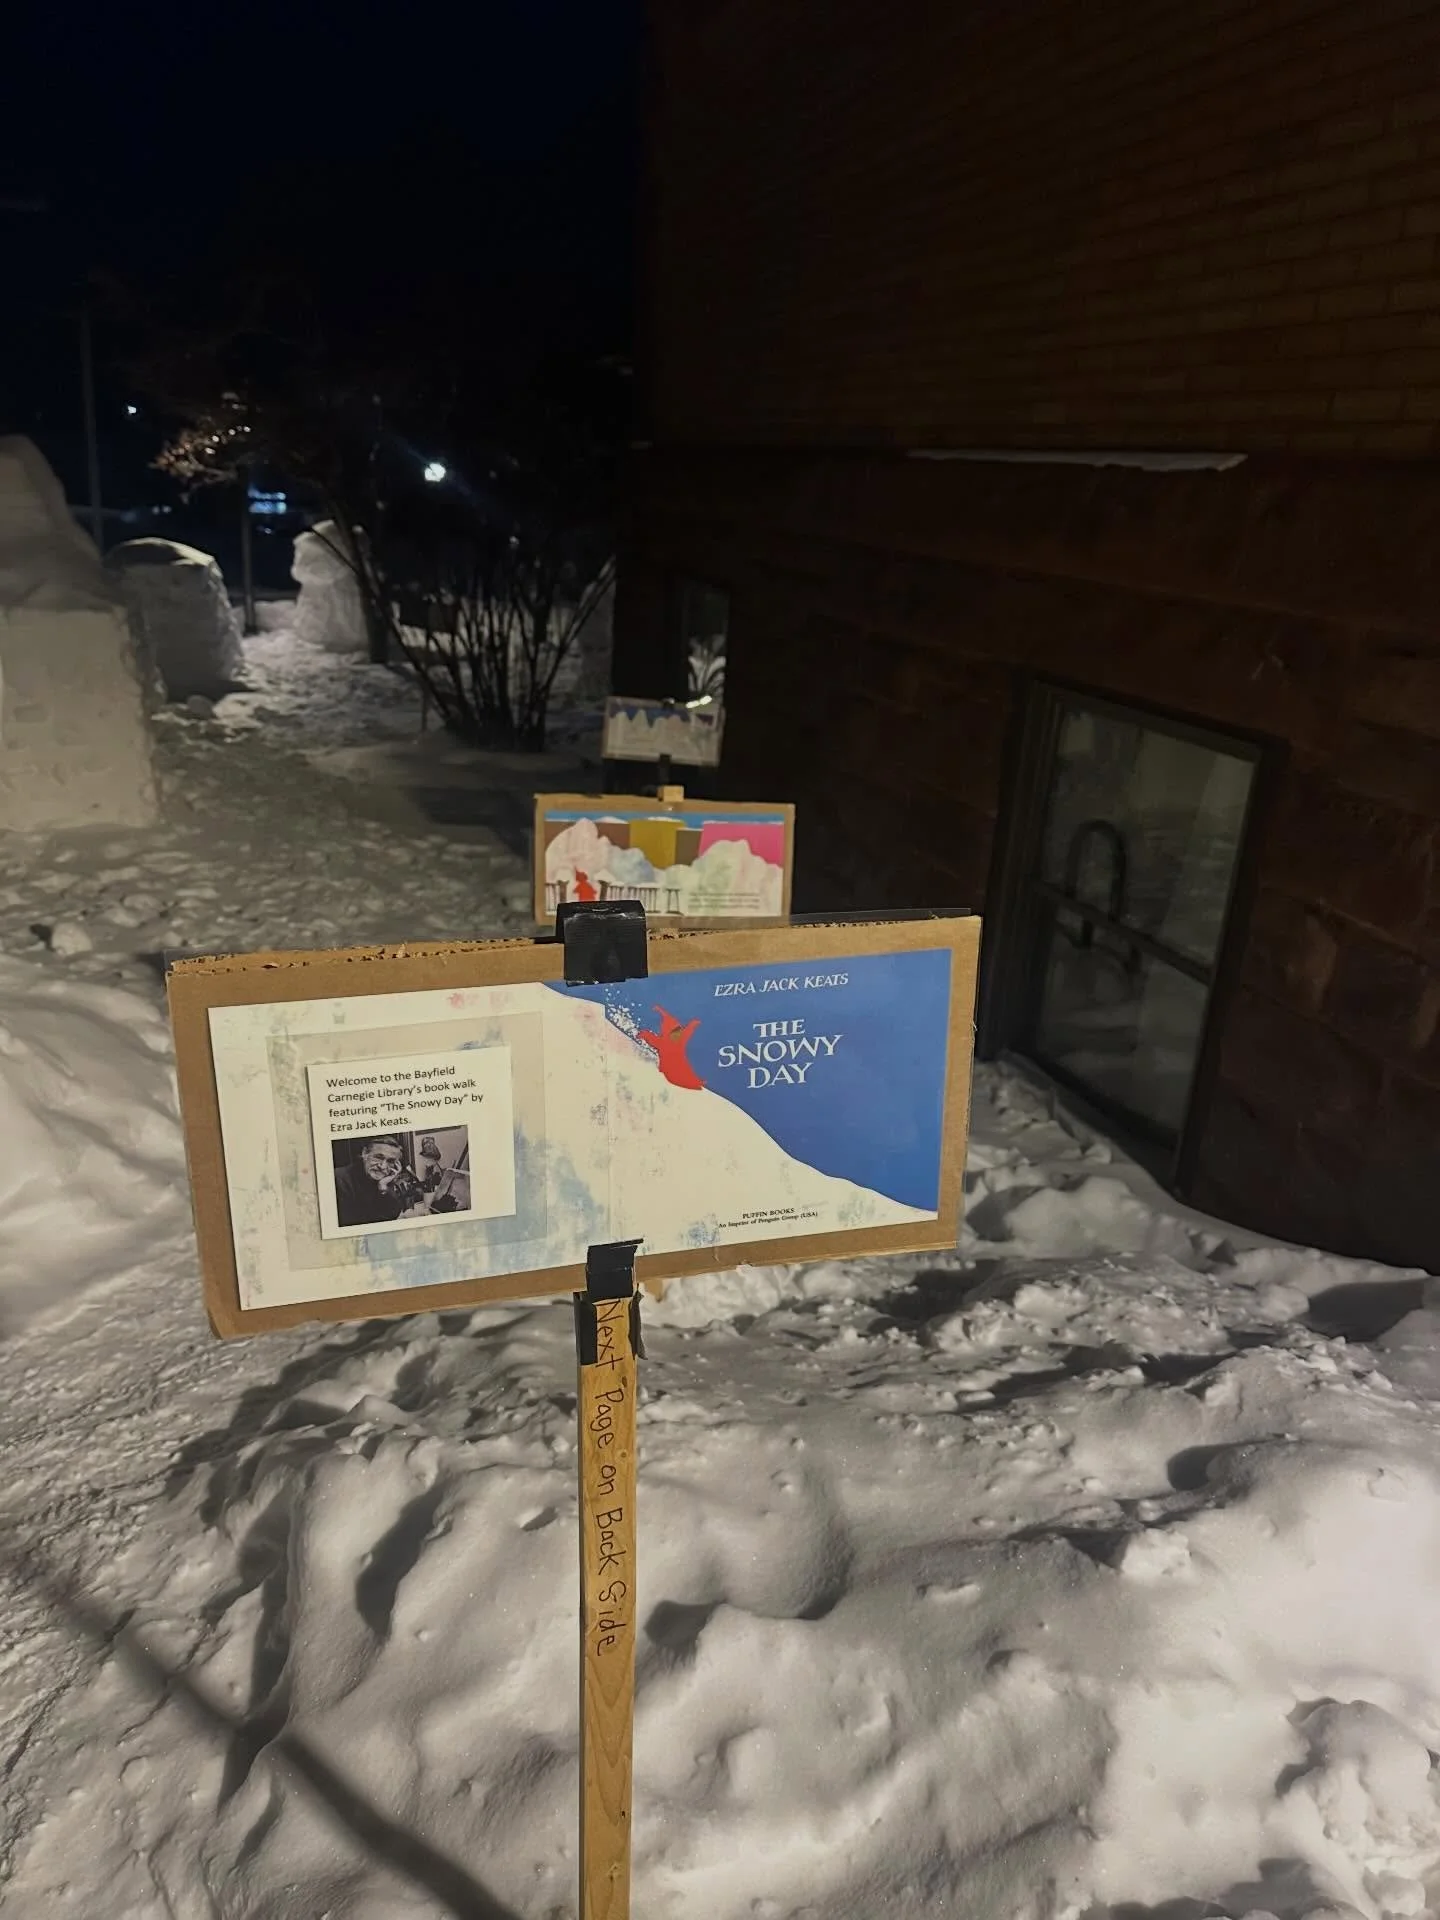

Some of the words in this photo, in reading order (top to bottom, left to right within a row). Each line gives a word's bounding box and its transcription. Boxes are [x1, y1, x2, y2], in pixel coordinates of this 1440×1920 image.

[714, 982, 756, 997] EZRA
[759, 977, 800, 993] JACK
[804, 973, 849, 989] KEATS
[752, 1019, 806, 1038] THE
[718, 1034, 844, 1068] SNOWY
[326, 1077, 377, 1088] Welcome
[380, 1075, 391, 1083] to
[394, 1072, 412, 1081] the
[415, 1066, 455, 1080] Bayfield
[747, 1062, 814, 1089] DAY
[328, 1090, 375, 1103] Carnegie
[424, 1081, 450, 1092] book
[452, 1079, 477, 1090] walk
[329, 1105, 378, 1118] featuring
[408, 1098, 442, 1109] Snowy
[471, 1093, 483, 1103] by
[330, 1123, 353, 1132] Ezra
[355, 1119, 378, 1130] Jack
[380, 1116, 412, 1127] Keats.
[742, 1211, 767, 1219] PUFFIN
[769, 1208, 795, 1216] BOOKS
[595, 1300, 625, 1370] Next
[590, 1388, 625, 1449] Page
[597, 1464, 617, 1496] on
[595, 1507, 627, 1575] Back
[597, 1580, 627, 1657] Side
